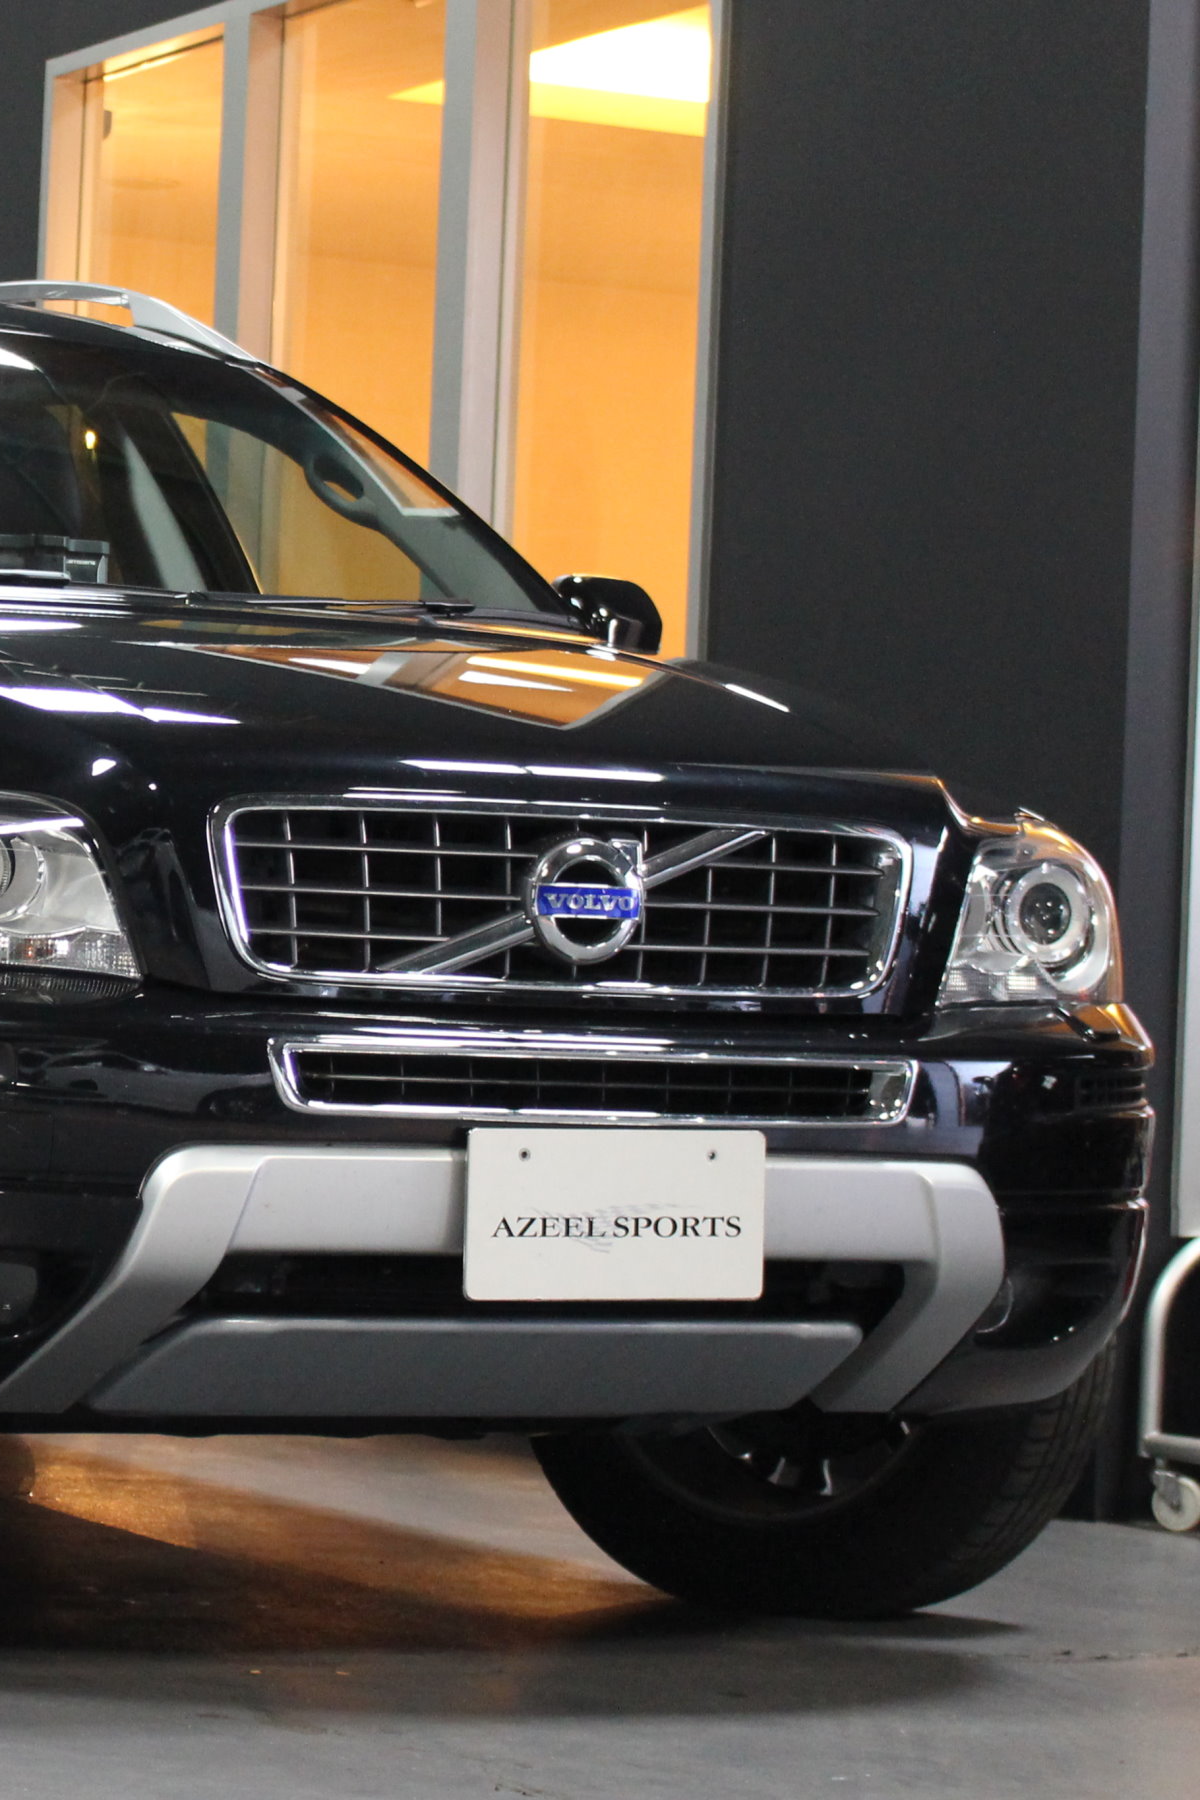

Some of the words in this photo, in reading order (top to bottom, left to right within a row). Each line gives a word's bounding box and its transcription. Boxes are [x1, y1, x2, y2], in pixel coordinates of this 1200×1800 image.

[544, 892, 634, 911] VOLVO
[492, 1216, 605, 1238] AZEEL
[613, 1216, 742, 1238] SPORTS
